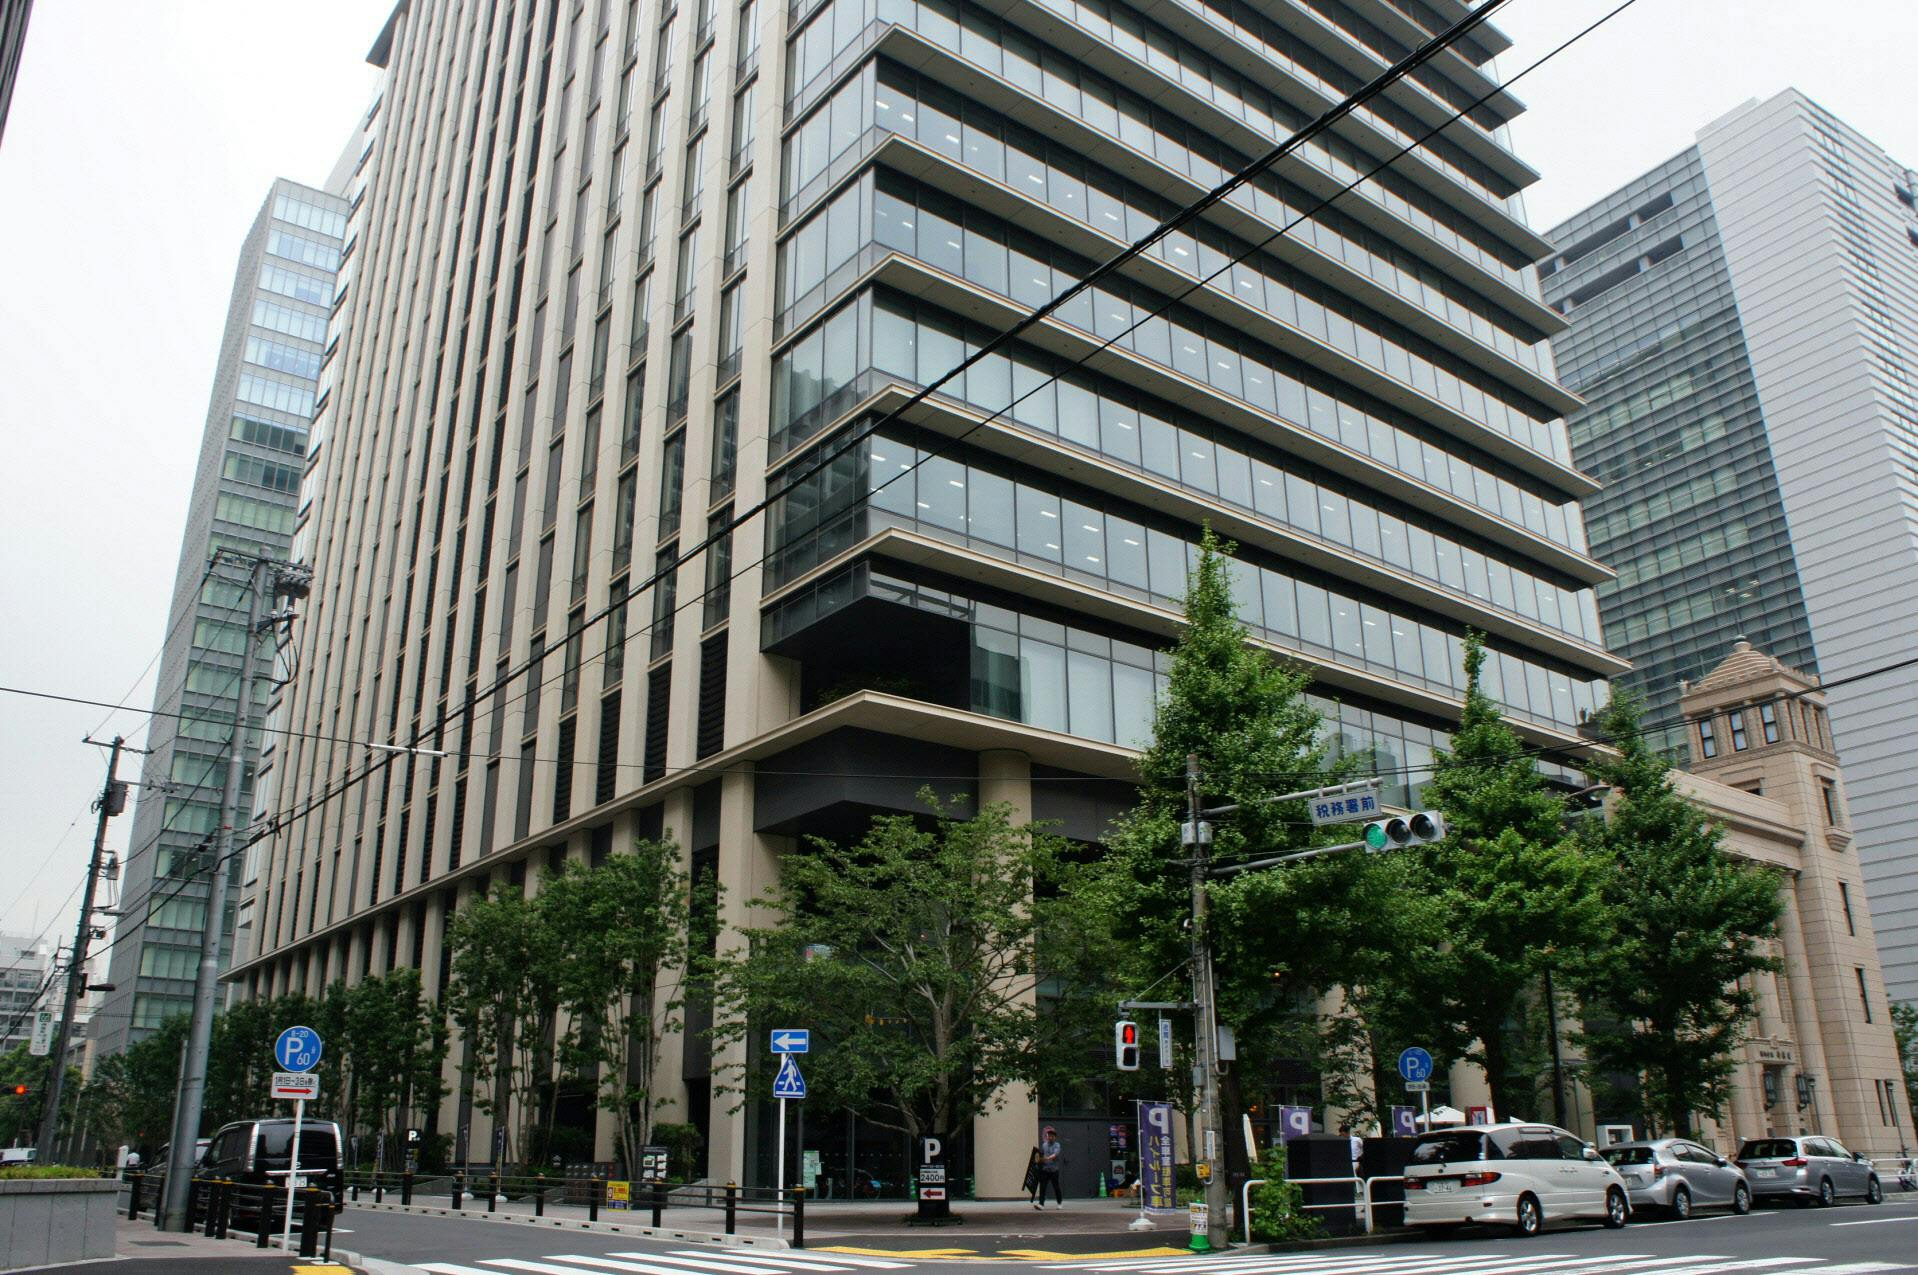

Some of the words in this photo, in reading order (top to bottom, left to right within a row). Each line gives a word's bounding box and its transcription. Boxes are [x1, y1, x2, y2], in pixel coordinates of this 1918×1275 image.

[1316, 795, 1375, 818] 税務署前
[285, 1037, 303, 1065] P
[1407, 1057, 1419, 1078] P
[925, 1138, 941, 1164] P
